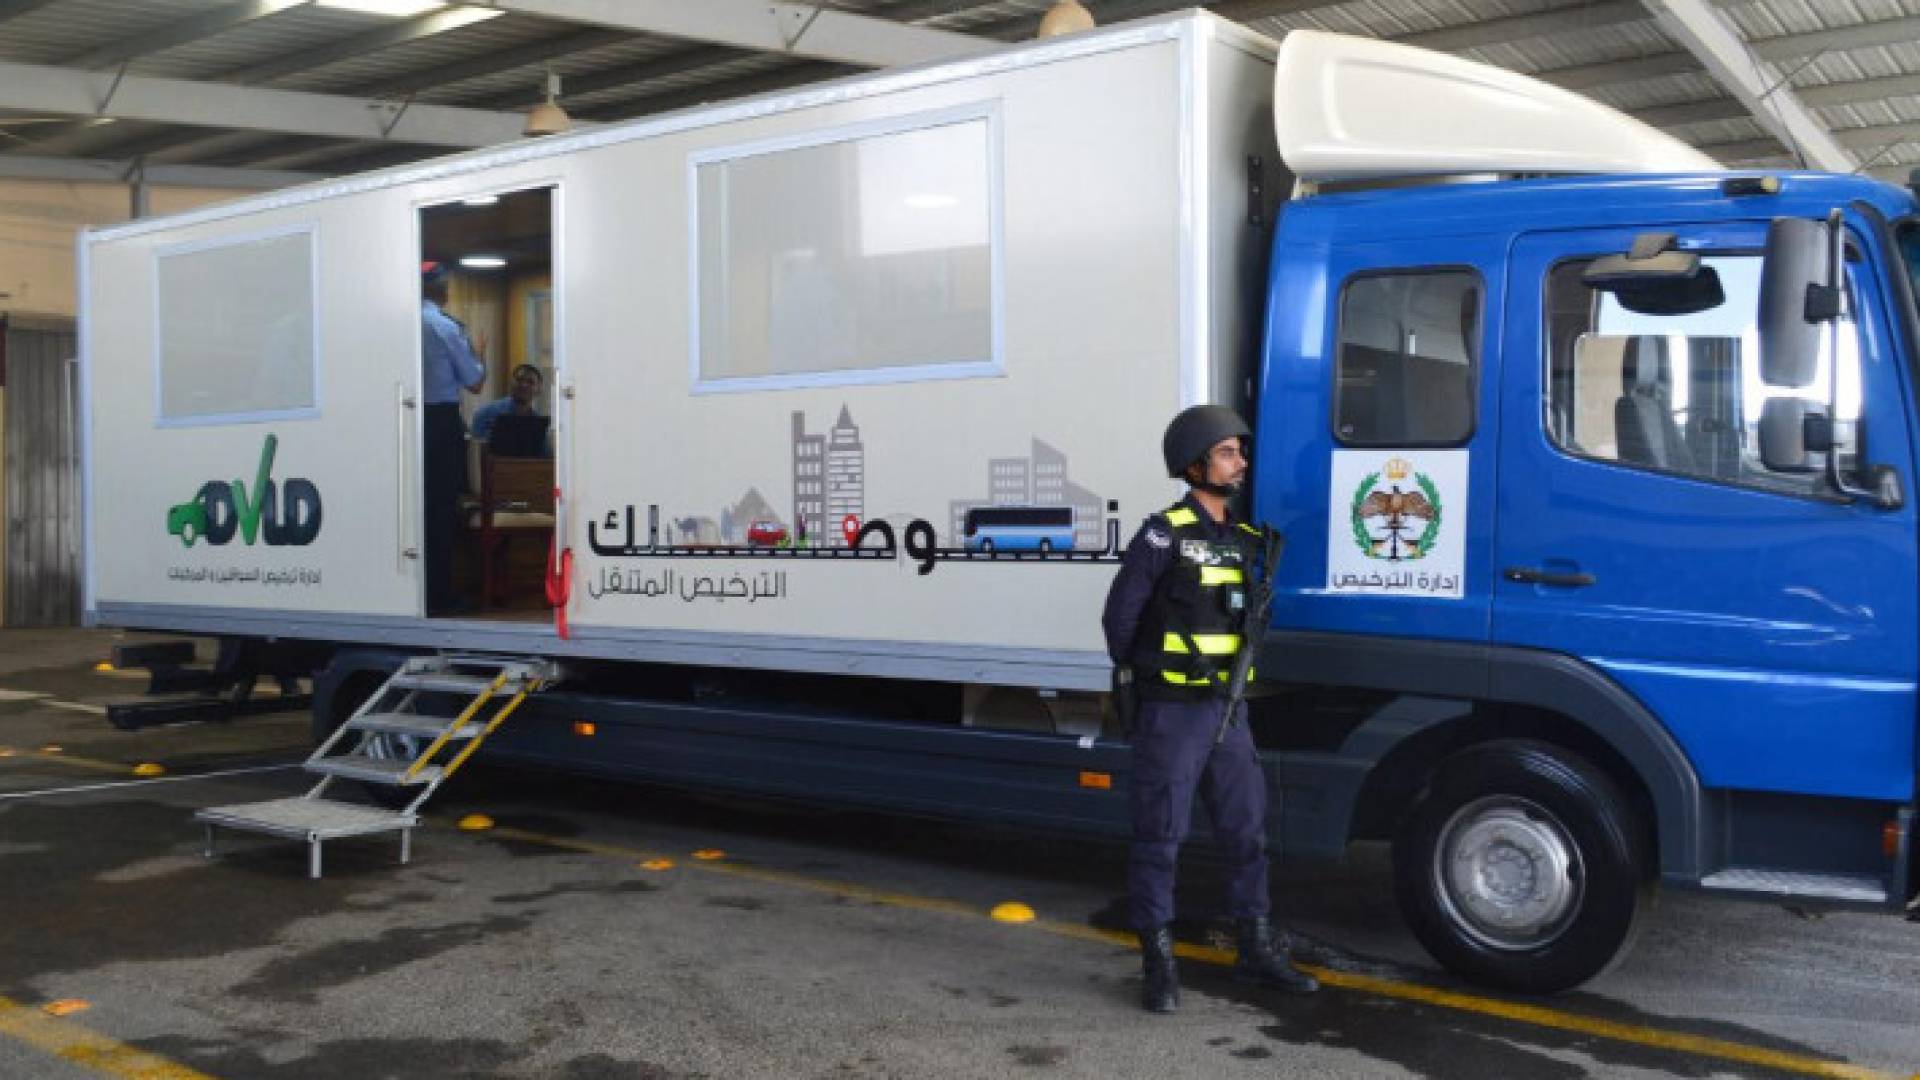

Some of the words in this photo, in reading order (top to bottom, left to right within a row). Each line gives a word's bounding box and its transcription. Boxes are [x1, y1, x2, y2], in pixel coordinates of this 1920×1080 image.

[588, 566, 673, 600] المتنقل
[680, 569, 787, 602] الترخيص
[1332, 570, 1413, 590] الترخيص
